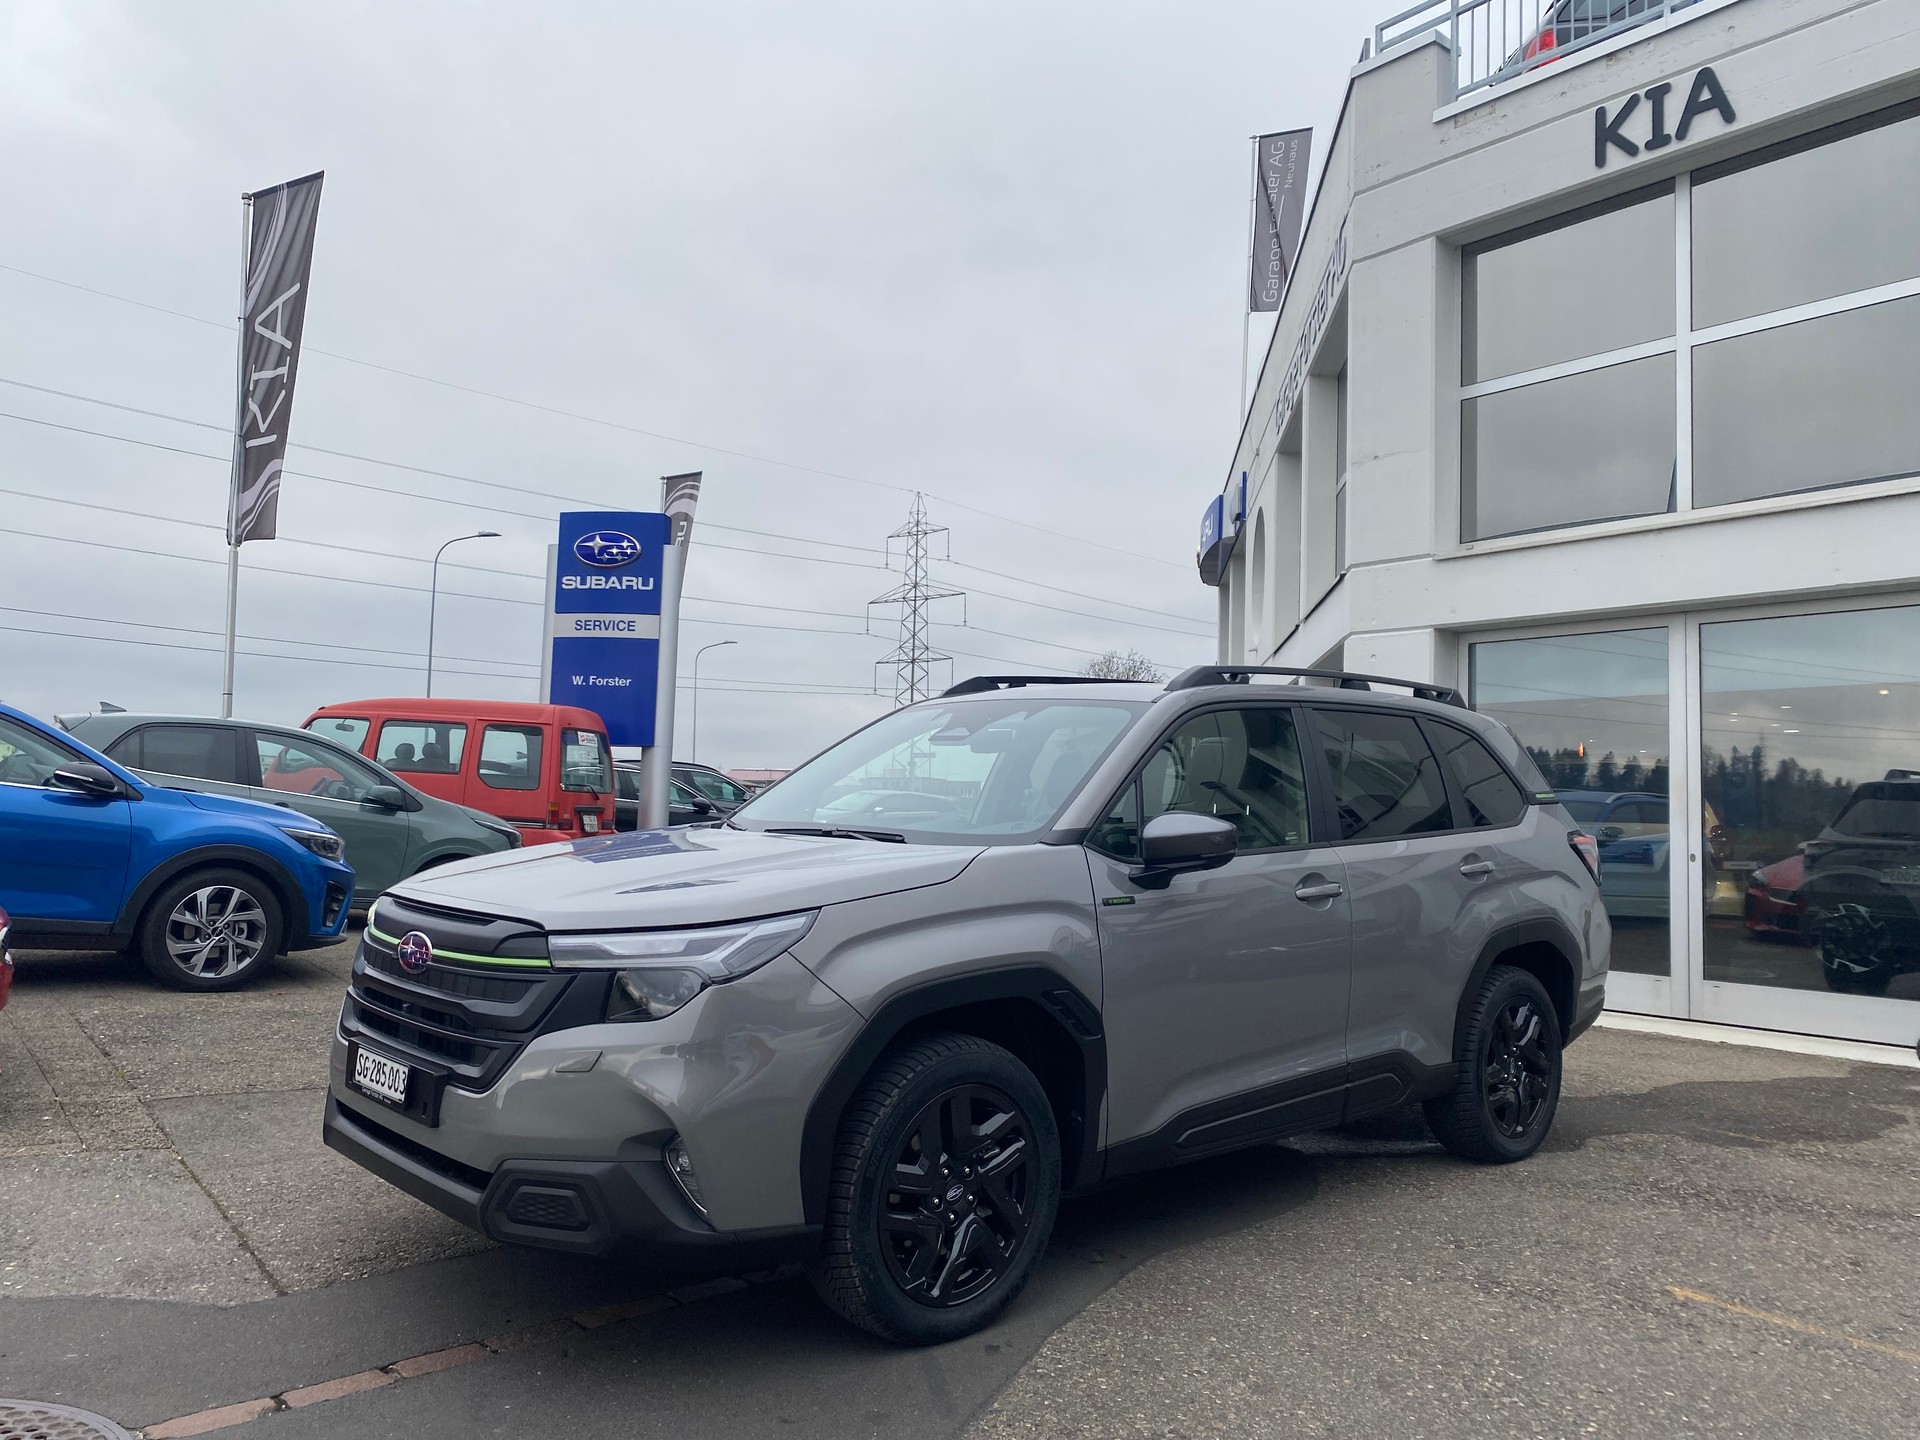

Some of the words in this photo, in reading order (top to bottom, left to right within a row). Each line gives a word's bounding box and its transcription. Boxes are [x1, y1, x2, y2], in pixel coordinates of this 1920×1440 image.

[1595, 66, 1736, 168] KIA
[1269, 141, 1285, 167] AG
[1284, 139, 1298, 189] Neuhaus
[1263, 237, 1281, 302] Garage
[246, 282, 300, 448] KIA
[561, 575, 654, 591] SUBARU
[574, 619, 636, 632] SERVICE
[572, 675, 586, 687] W.
[589, 675, 632, 687] Forster
